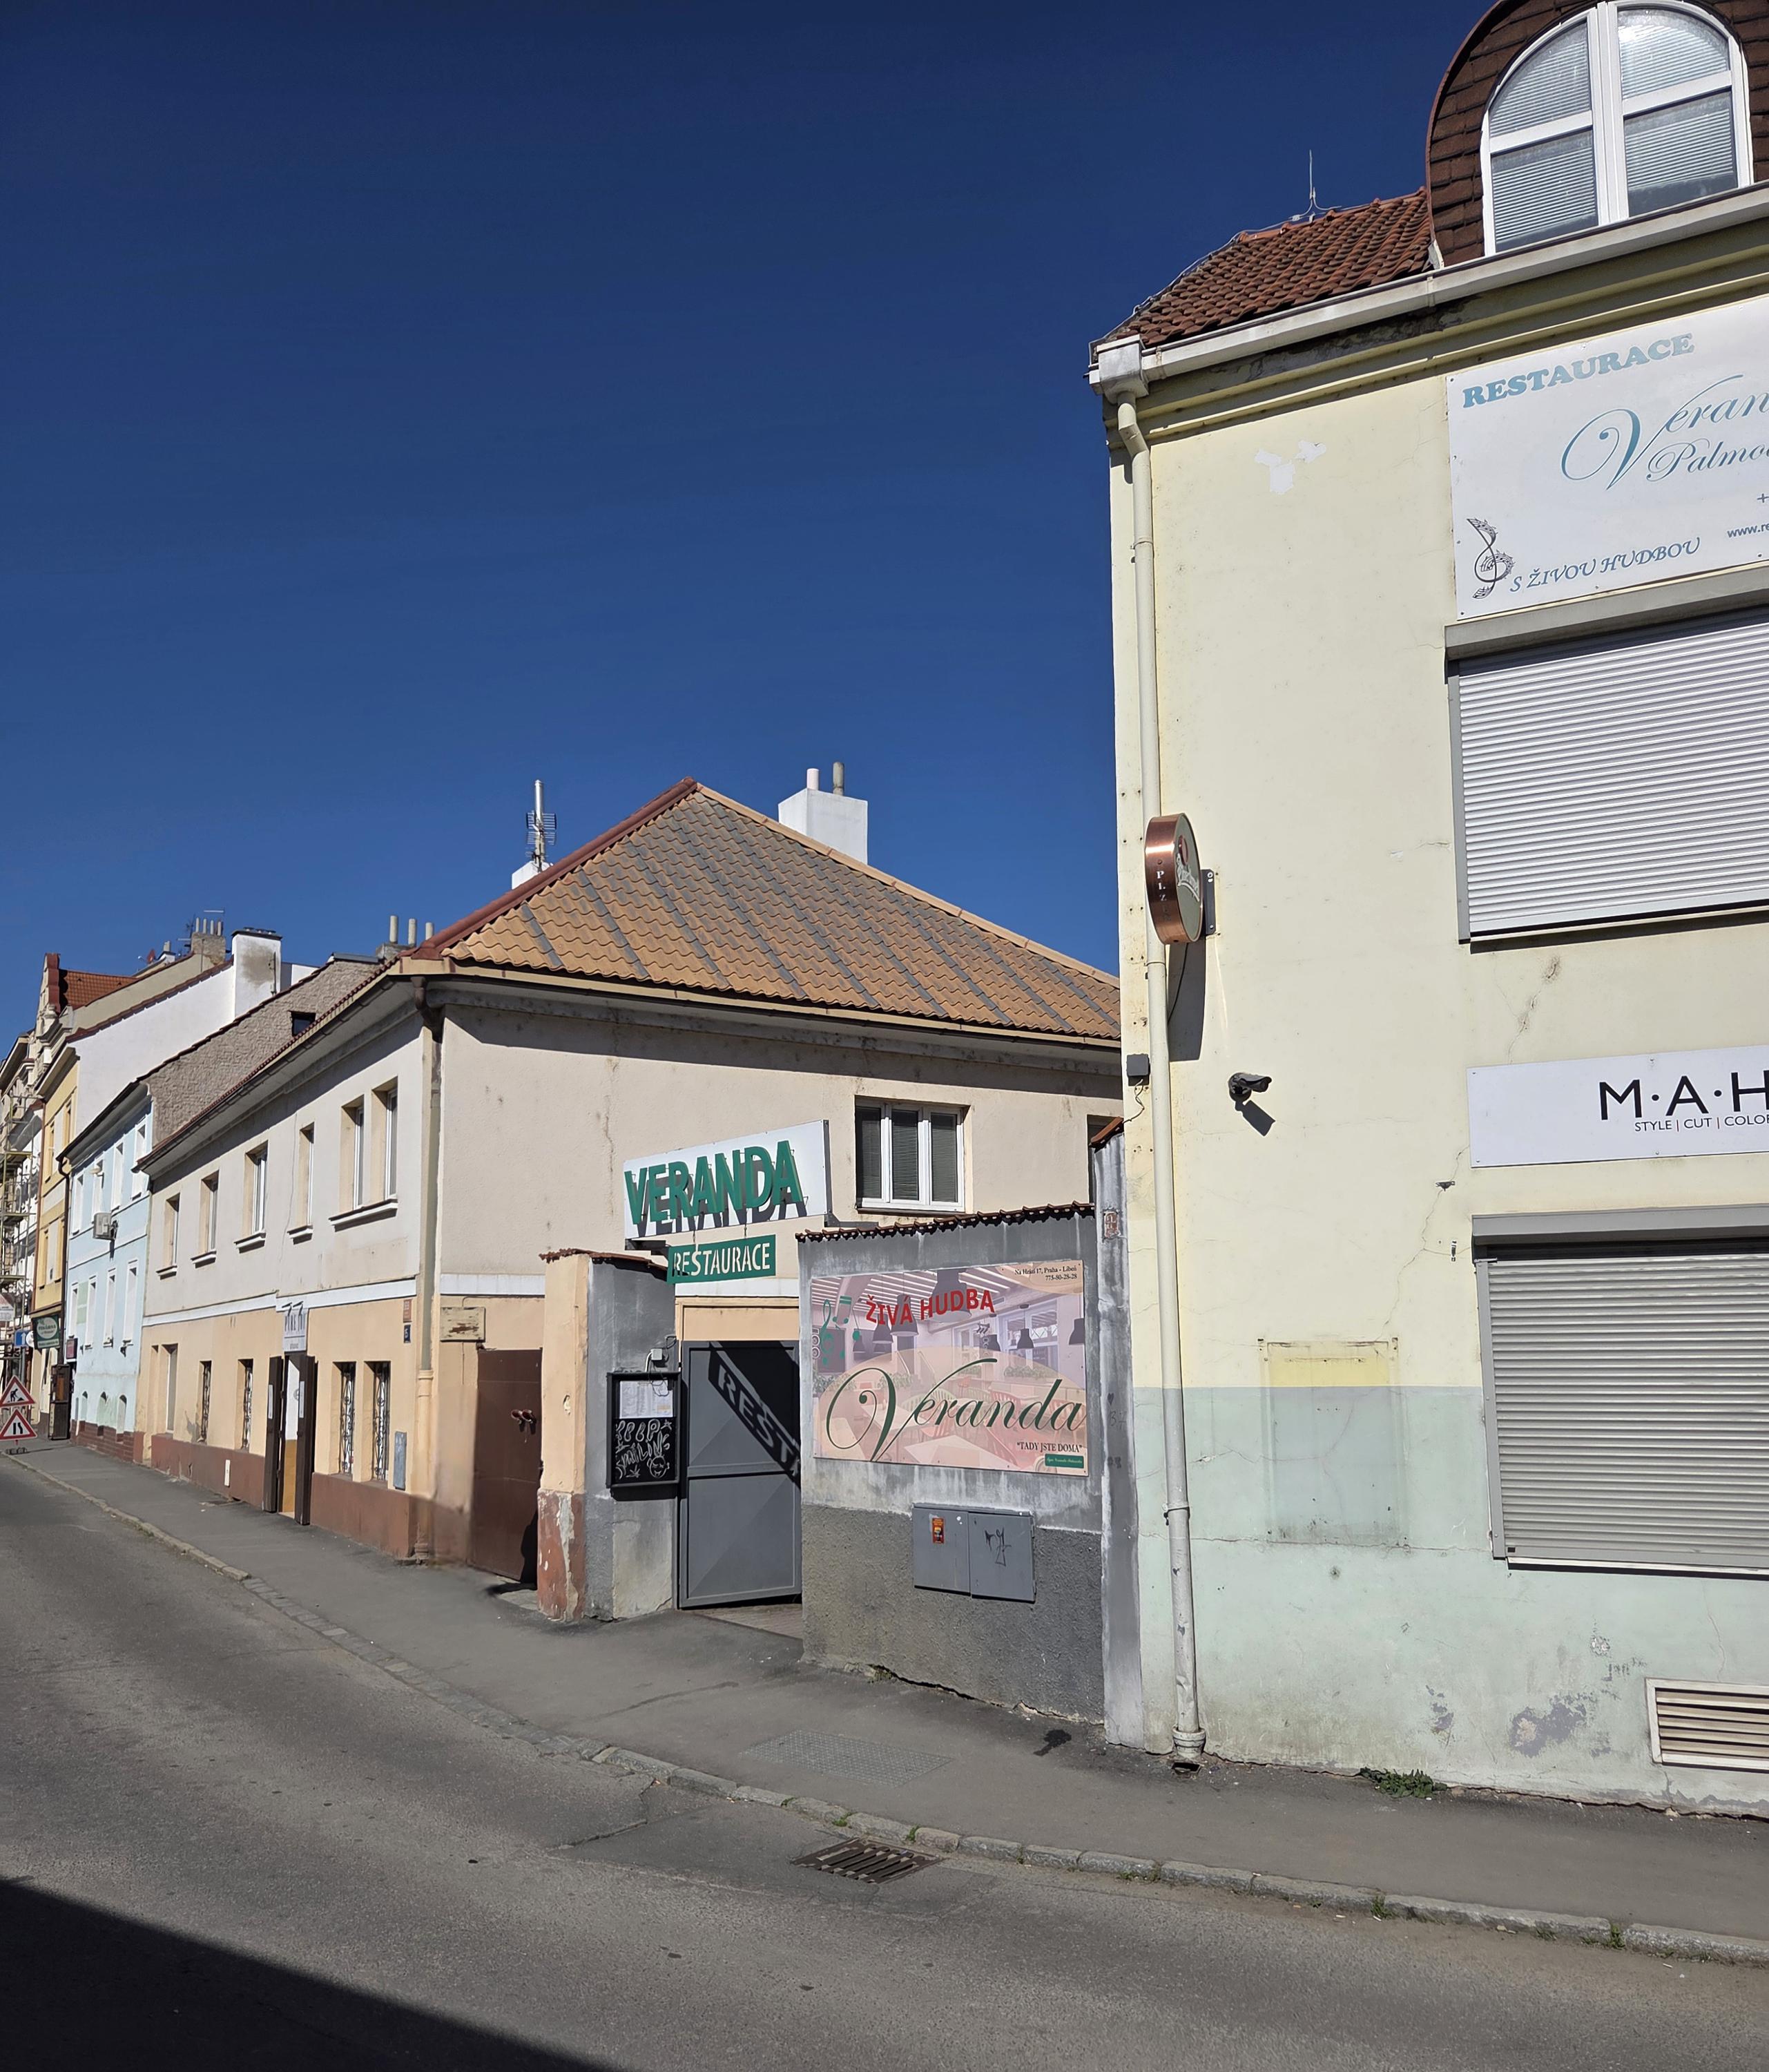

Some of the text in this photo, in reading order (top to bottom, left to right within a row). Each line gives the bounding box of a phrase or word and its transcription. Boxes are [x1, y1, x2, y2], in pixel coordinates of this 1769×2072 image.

[1462, 333, 1695, 408] RESTAURACE
[1646, 438, 1769, 481] Palmo
[1509, 537, 1701, 592] S ŽIVOU HUDBOU
[1634, 1120, 1672, 1131] STYLE
[1683, 1117, 1712, 1129] CUT
[624, 1140, 804, 1225] VERANDA
[672, 1243, 771, 1278] RESTAURACE
[866, 1287, 995, 1326] ŽIVÁ HUDBA
[826, 1358, 1087, 1462] Veranda
[1040, 1442, 1056, 1452] JSTE
